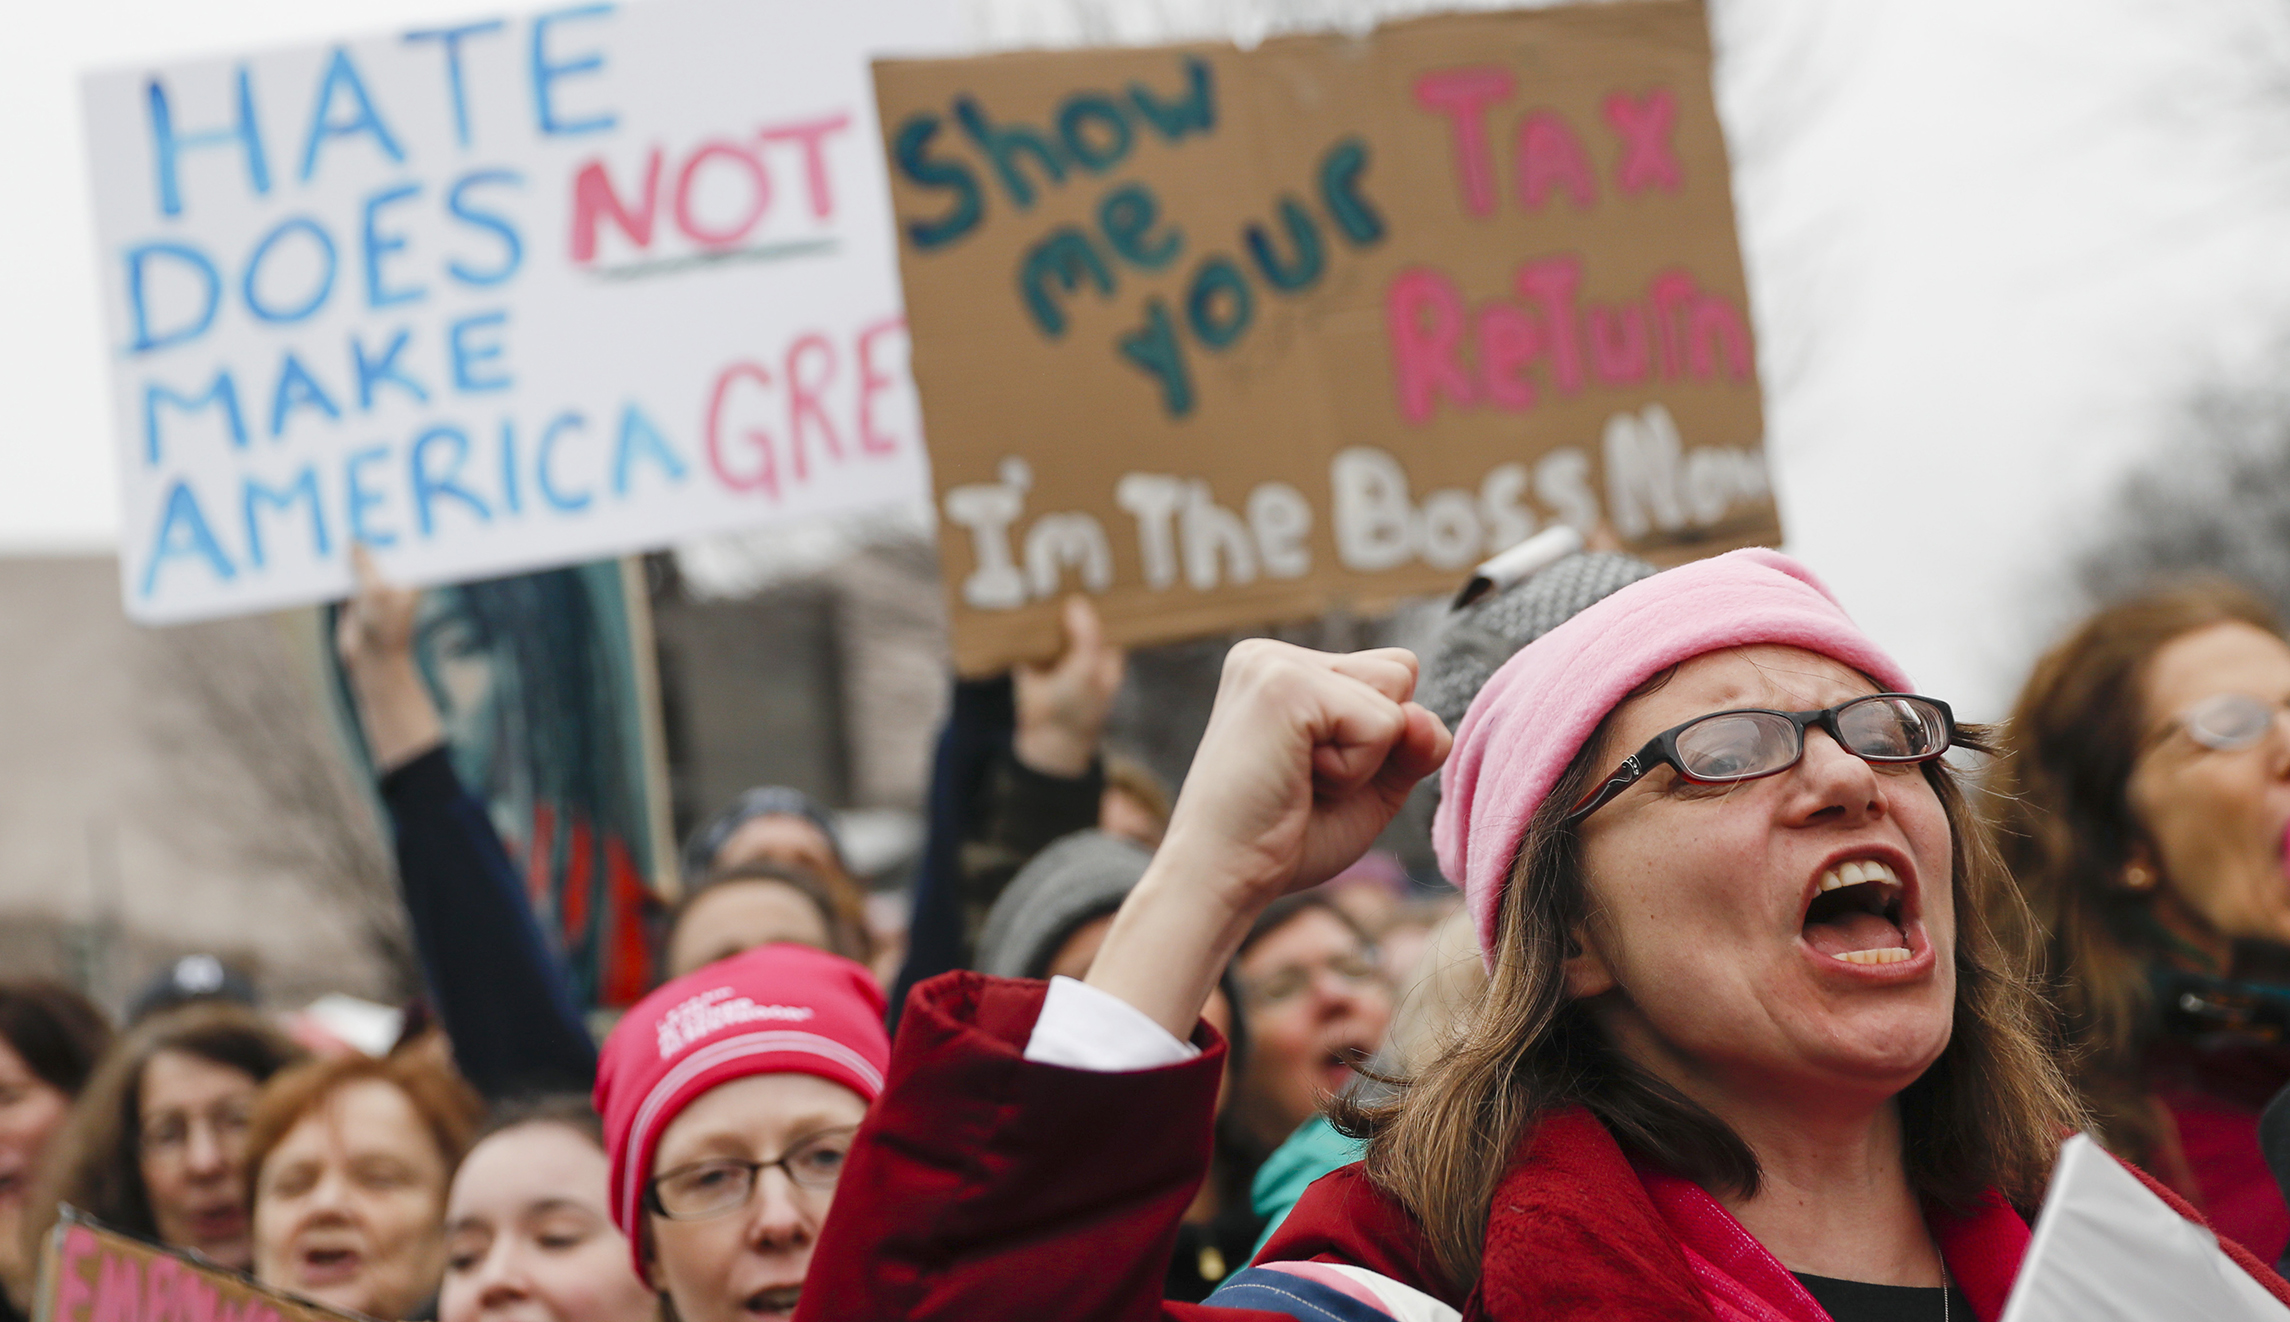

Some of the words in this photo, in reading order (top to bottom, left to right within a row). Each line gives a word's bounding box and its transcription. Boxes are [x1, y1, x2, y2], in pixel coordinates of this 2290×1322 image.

[147, 4, 618, 217] HATE
[891, 54, 1217, 254] Show
[122, 170, 527, 357] DOES
[569, 115, 852, 265] NOT
[1018, 184, 1184, 340] me
[1117, 136, 1386, 419] your
[141, 403, 690, 598] AMERICA
[704, 315, 908, 502] GRE
[142, 311, 514, 467] MAKE
[943, 457, 1111, 610] I'm
[1117, 474, 1313, 590] The
[1331, 446, 1595, 571] Boss
